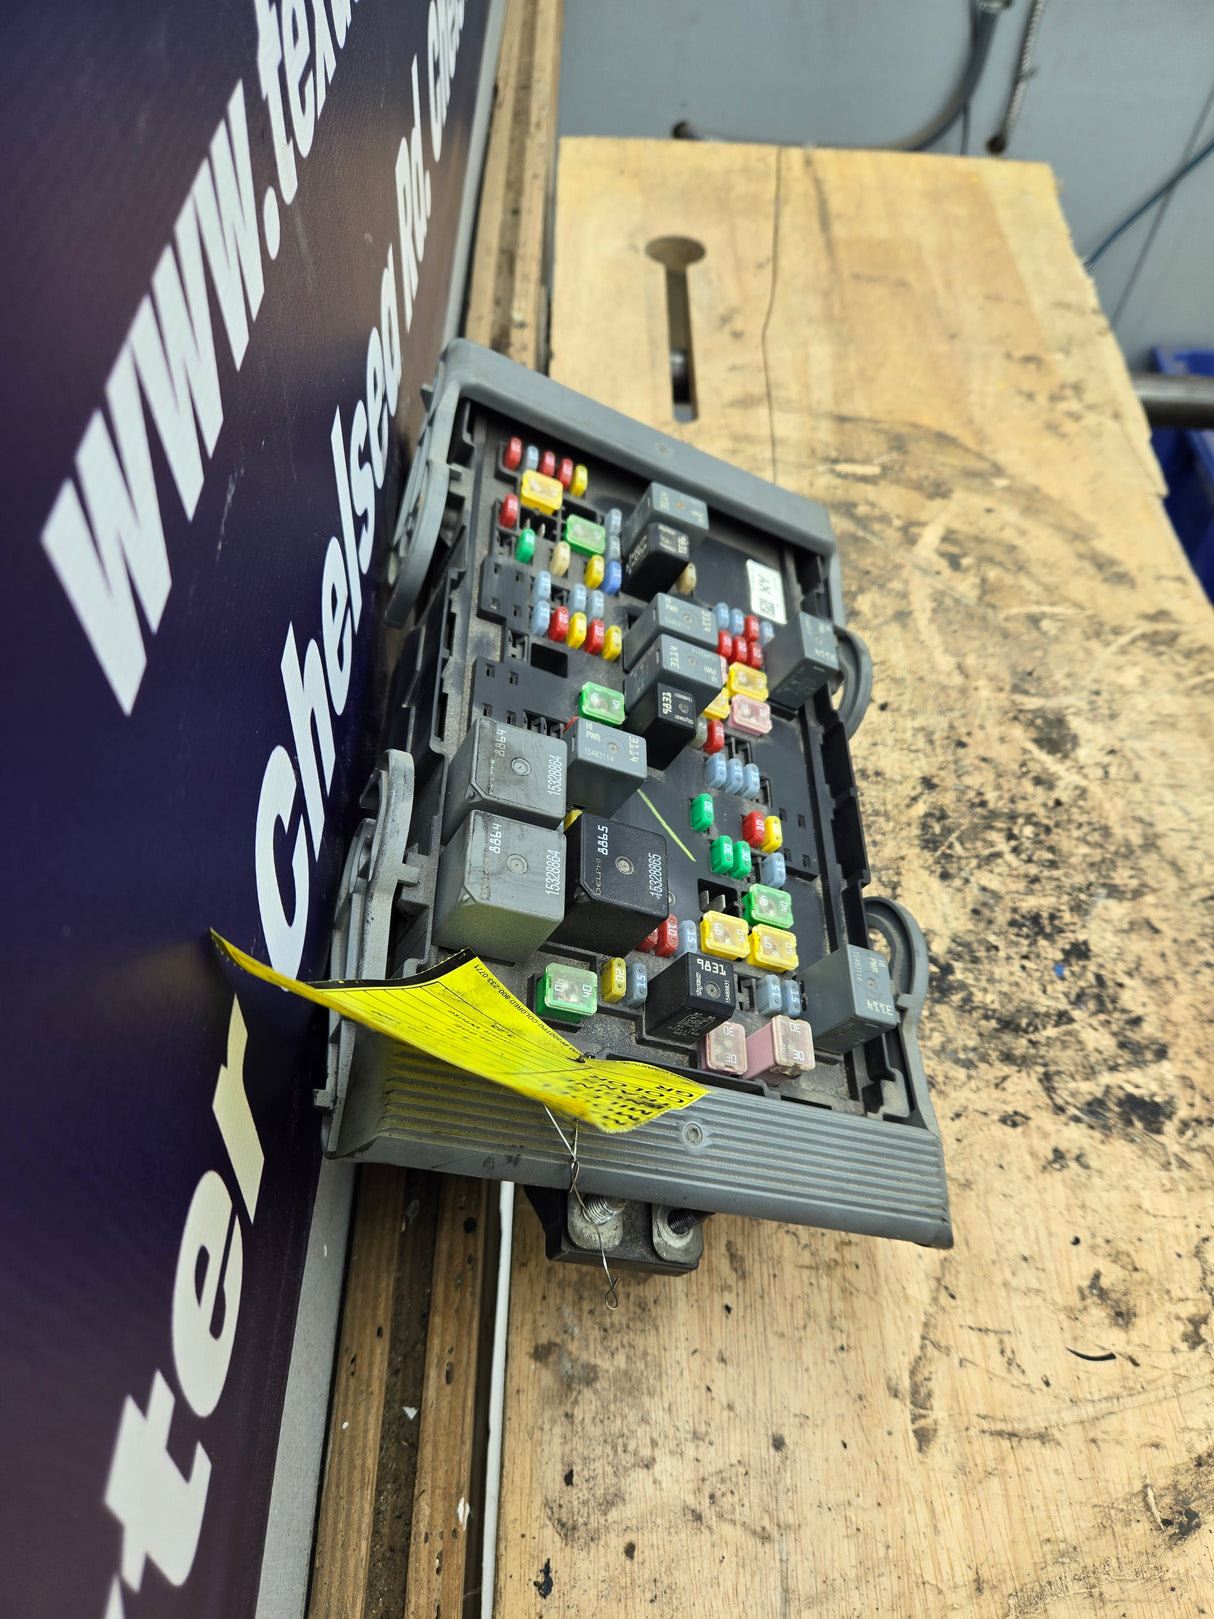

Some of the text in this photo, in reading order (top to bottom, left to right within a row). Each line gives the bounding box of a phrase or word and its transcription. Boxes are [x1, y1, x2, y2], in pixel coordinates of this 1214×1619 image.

[254, 243, 402, 993] Chelsea
[395, 53, 432, 335] Rd.
[586, 730, 601, 742] PWR
[716, 726, 725, 737] 10
[629, 735, 640, 762] 3114
[717, 759, 727, 771] 15
[734, 765, 743, 777] 15
[547, 754, 563, 796] 15328864
[751, 771, 760, 782] 15
[703, 800, 713, 813] 30
[756, 818, 765, 832] 10
[488, 822, 502, 854] 8864
[597, 824, 609, 856] 8865
[723, 843, 733, 857] 30
[741, 849, 751, 862] 30
[544, 849, 561, 896] 15328864
[775, 860, 785, 872] 15
[648, 852, 663, 899] 15328865
[780, 900, 788, 912] 40
[667, 923, 677, 937] 10
[713, 921, 723, 936] 60
[736, 928, 745, 942] 60
[687, 930, 697, 944] 15
[763, 935, 773, 949] 60
[784, 941, 794, 956] 60
[696, 958, 727, 976] 9831
[473, 963, 510, 1000] 800-233-0771
[615, 967, 625, 983] 20
[636, 974, 646, 989] 15
[554, 978, 565, 992] 40
[582, 984, 592, 999] 40
[772, 984, 781, 998] 15
[790, 989, 800, 1003] 15
[866, 999, 894, 1017] 3114
[722, 1024, 736, 1037] 30
[789, 1022, 801, 1034] 30
[726, 1052, 737, 1064] 30
[793, 1050, 805, 1061] 30
